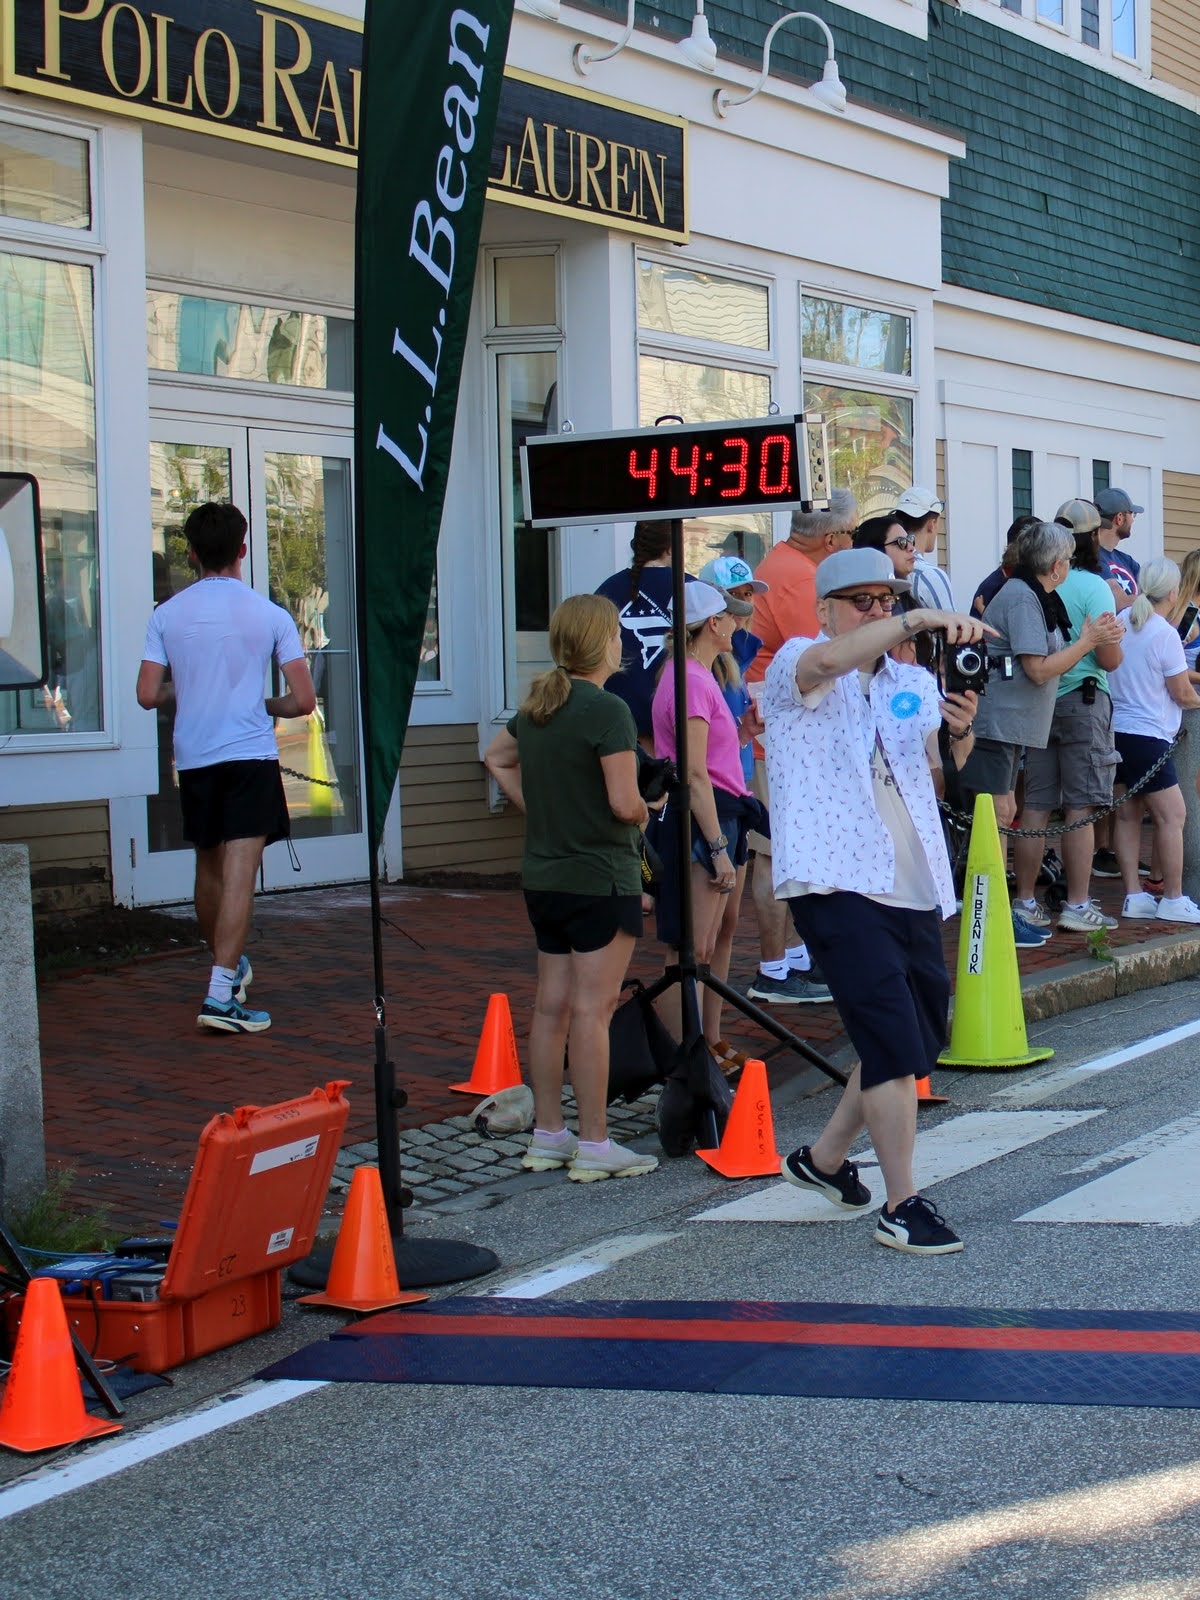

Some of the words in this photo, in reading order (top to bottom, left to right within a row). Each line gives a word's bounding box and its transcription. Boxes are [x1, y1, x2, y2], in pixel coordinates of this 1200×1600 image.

[36, 0, 240, 119] POLO
[375, 8, 491, 492] L.L.Bean
[629, 435, 791, 498] 44:30
[972, 900, 983, 939] BEAN
[969, 944, 979, 974] 10K
